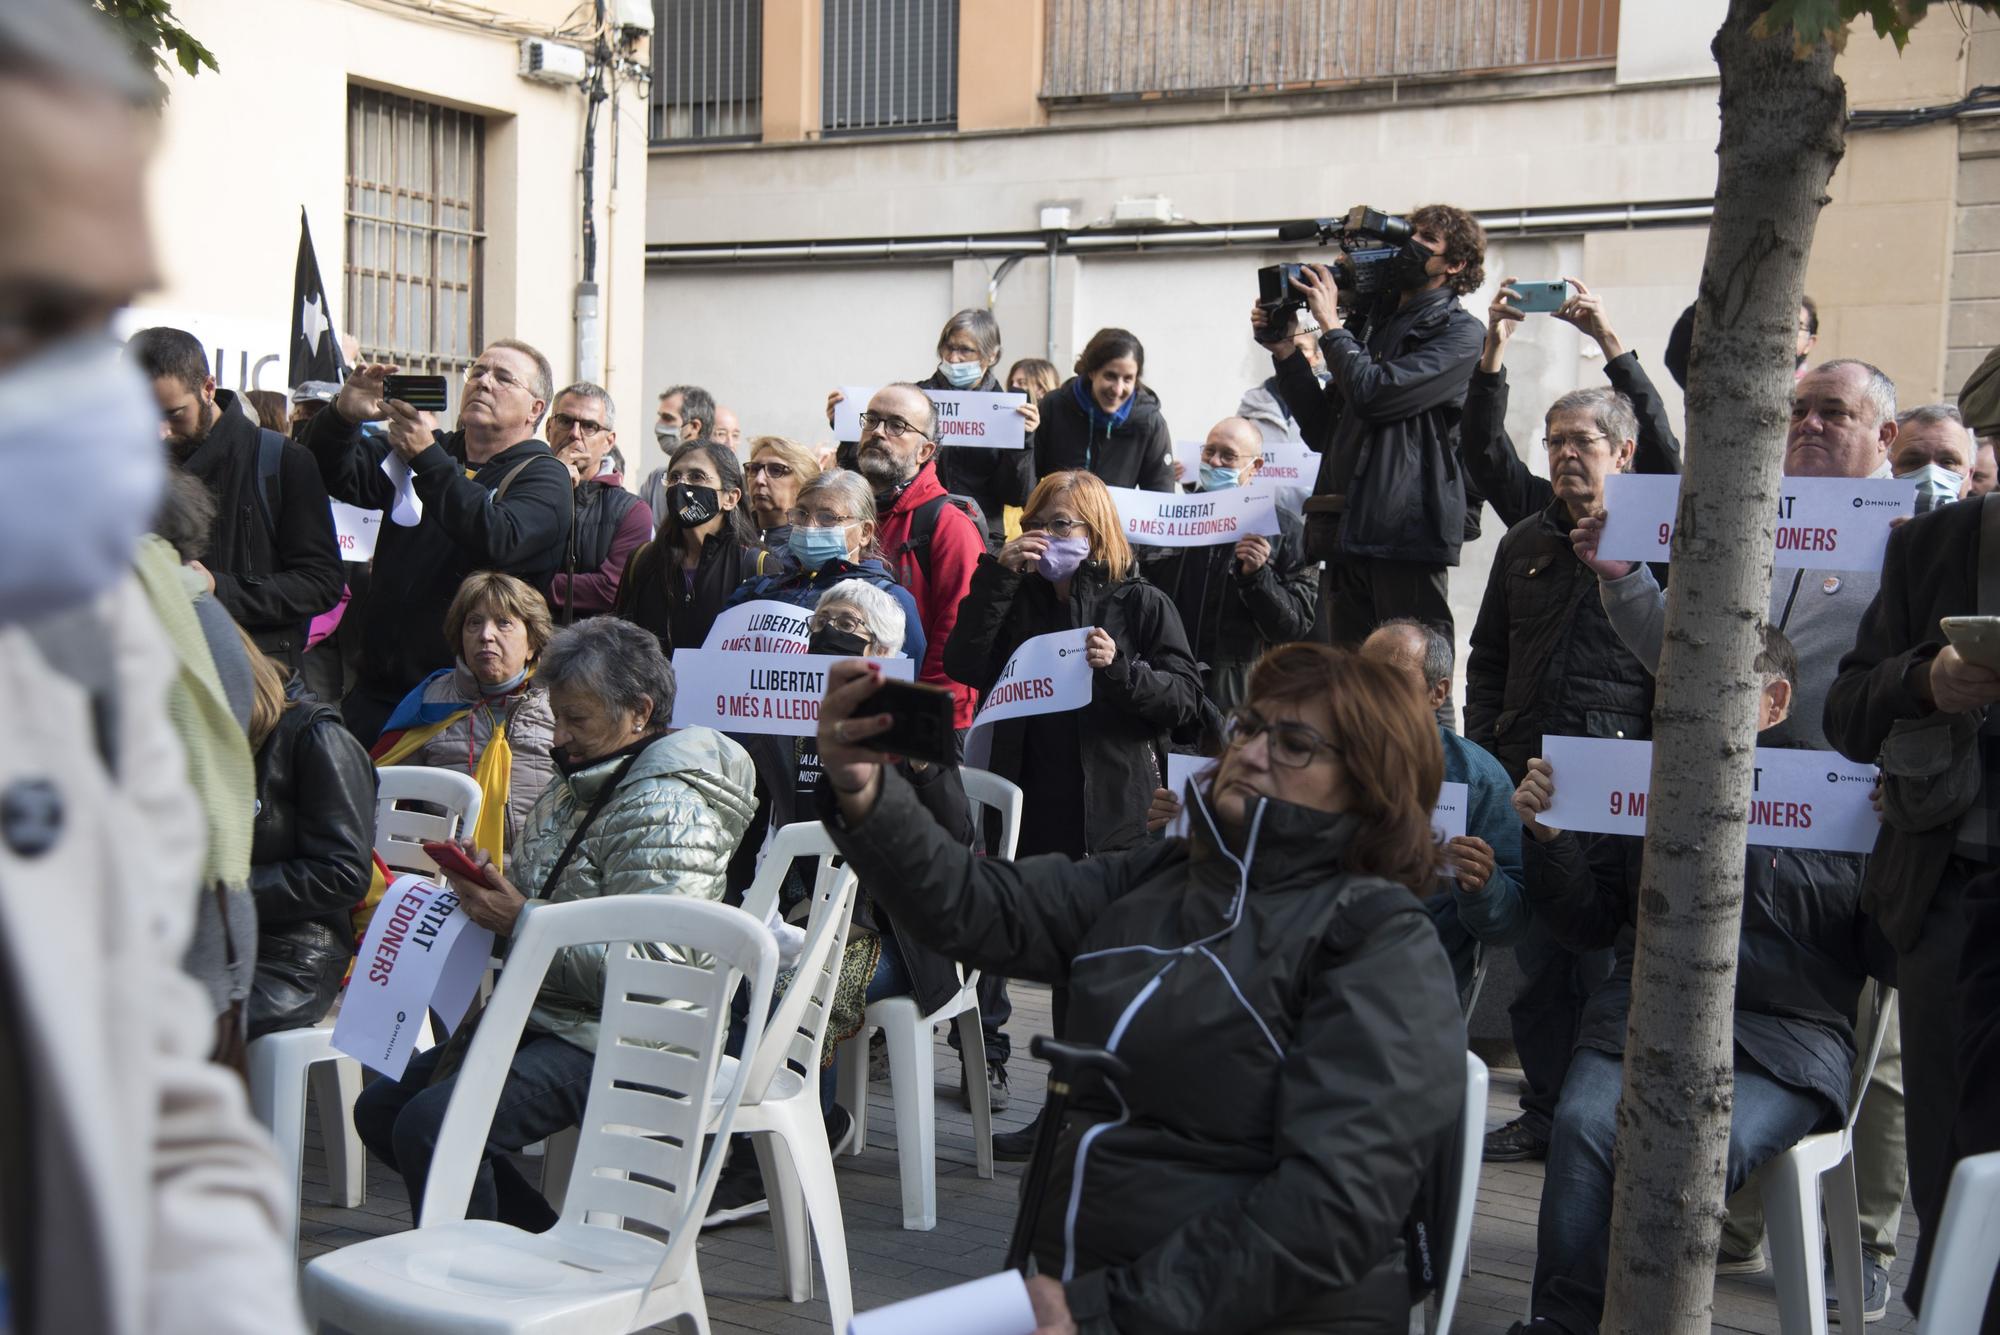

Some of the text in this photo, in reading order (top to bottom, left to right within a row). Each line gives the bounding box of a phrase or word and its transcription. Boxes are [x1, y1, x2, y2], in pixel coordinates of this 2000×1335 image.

[1158, 502, 1215, 518] LLIBERTAT
[1129, 518, 1137, 532] 9
[1167, 522, 1175, 536] A
[1178, 517, 1237, 536] LLEDONERS
[1658, 523, 1670, 545] 9
[750, 669, 824, 693] LLIBERTAT
[717, 695, 725, 715] 9
[730, 692, 759, 718] MÉS
[763, 698, 773, 718] A
[1610, 791, 1622, 815] 9
[1627, 792, 1649, 816] M
